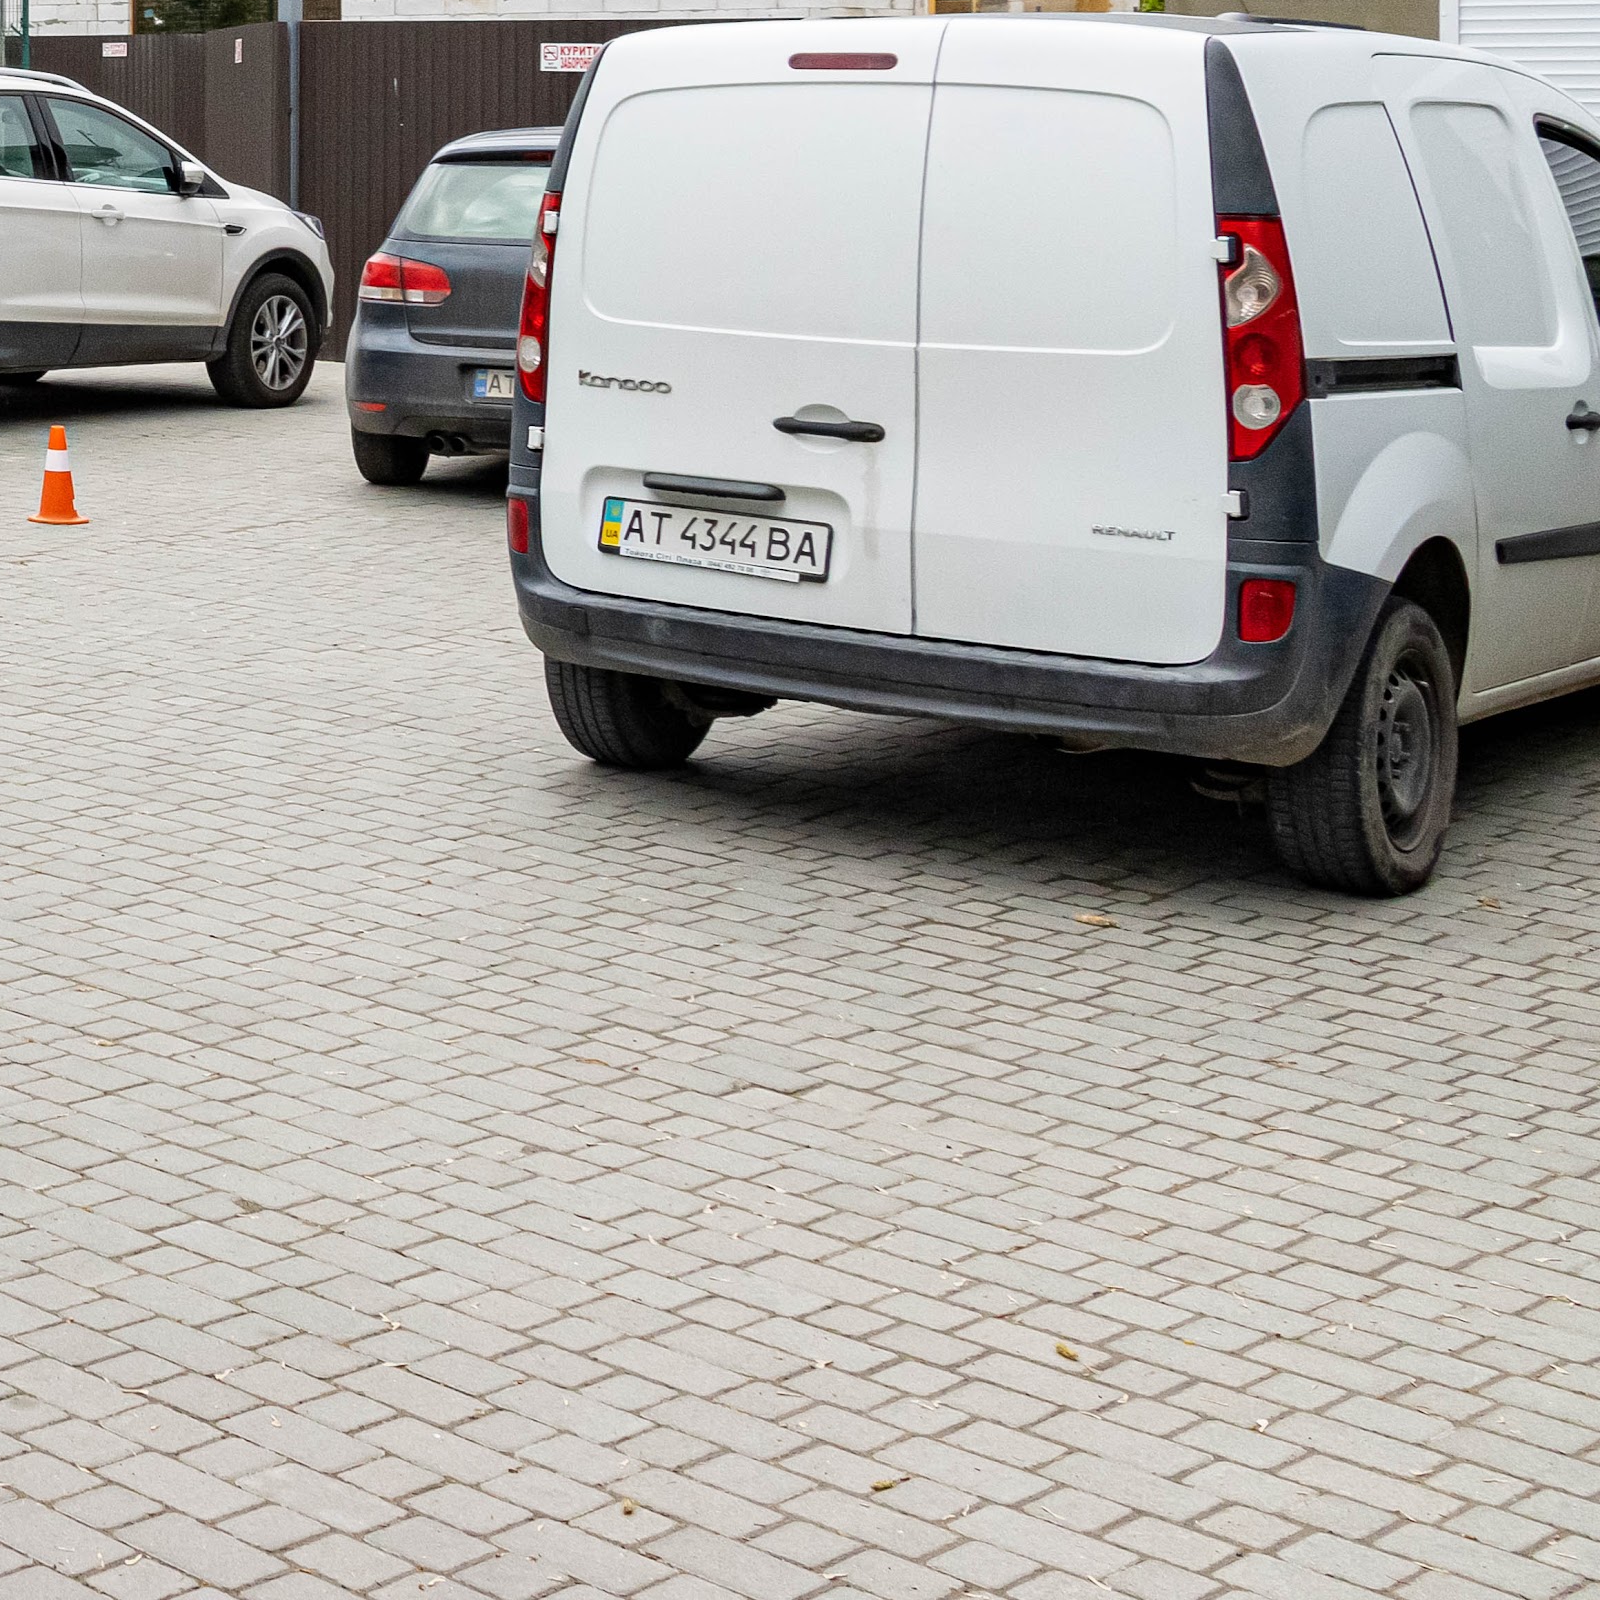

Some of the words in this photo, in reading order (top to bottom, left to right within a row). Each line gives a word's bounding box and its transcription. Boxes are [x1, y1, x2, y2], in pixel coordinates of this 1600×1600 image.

[560, 46, 600, 56] КУРИТИ
[605, 529, 619, 539] UA
[623, 509, 673, 545] AT
[680, 516, 757, 558] 4344
[766, 526, 817, 567] BA
[1092, 523, 1177, 541] RENAULT
